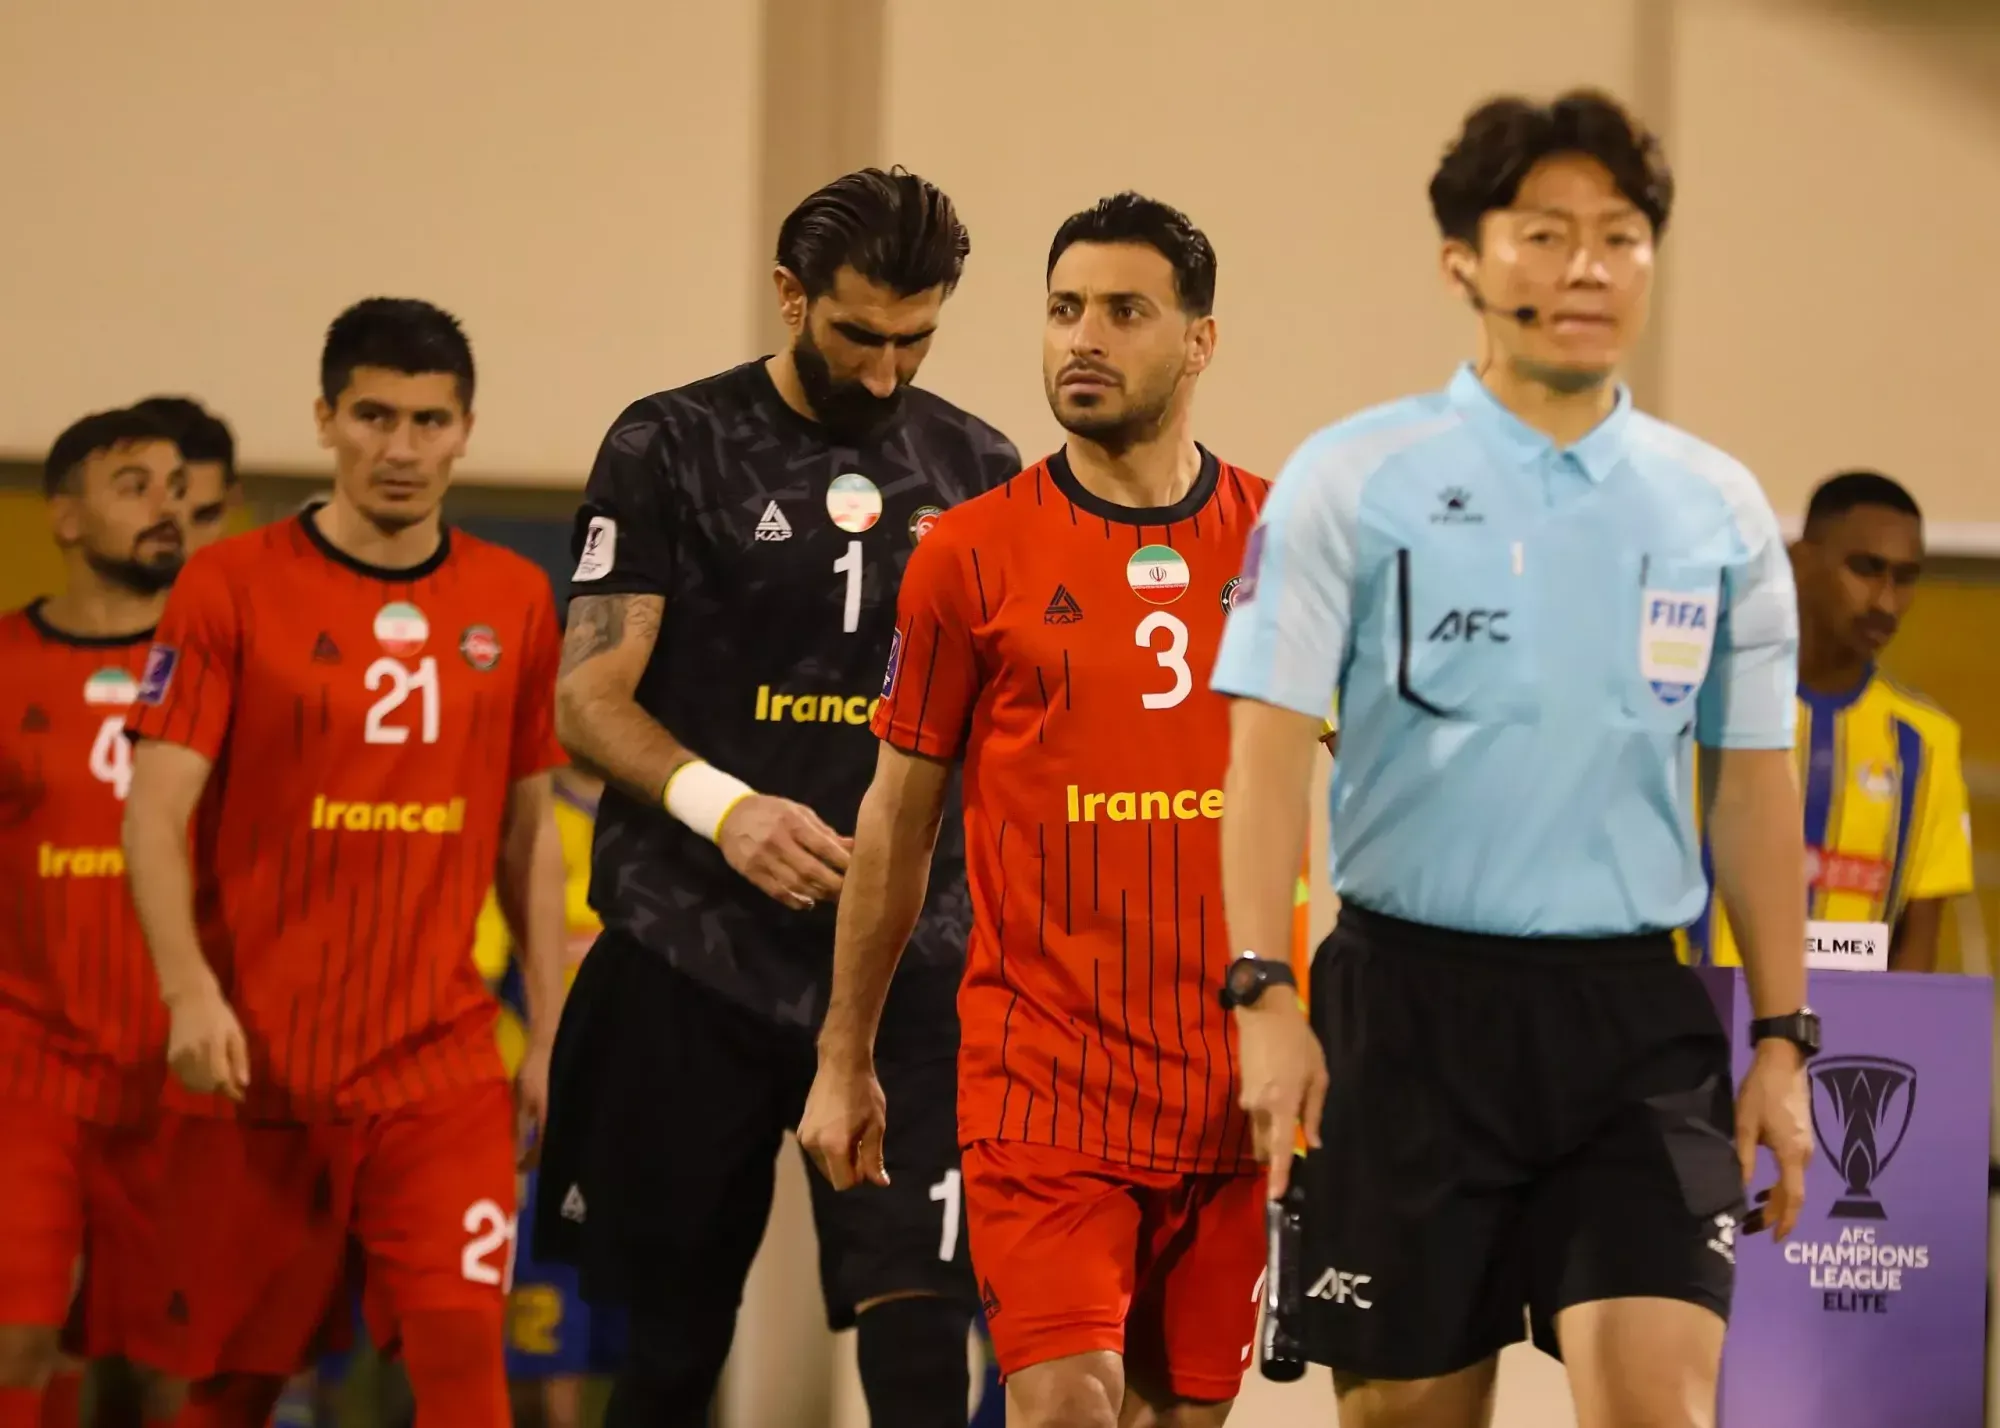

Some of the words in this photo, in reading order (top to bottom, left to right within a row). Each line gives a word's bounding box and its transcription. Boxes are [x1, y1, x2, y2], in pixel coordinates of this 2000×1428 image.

[833, 540, 863, 633] 1
[1044, 613, 1084, 625] KAP
[1427, 609, 1511, 643] AFC
[1650, 599, 1706, 629] FIFA
[1135, 610, 1193, 710] 3
[363, 655, 441, 745] 21
[88, 714, 134, 801] 4
[929, 1168, 961, 1262] 1
[1839, 1226, 1876, 1244] AFC
[1783, 1241, 1929, 1268] CHAMPIONS
[1306, 1266, 1373, 1309] AFC
[1809, 1267, 1902, 1291] LEAGUE
[1822, 1291, 1888, 1314] ELITE
